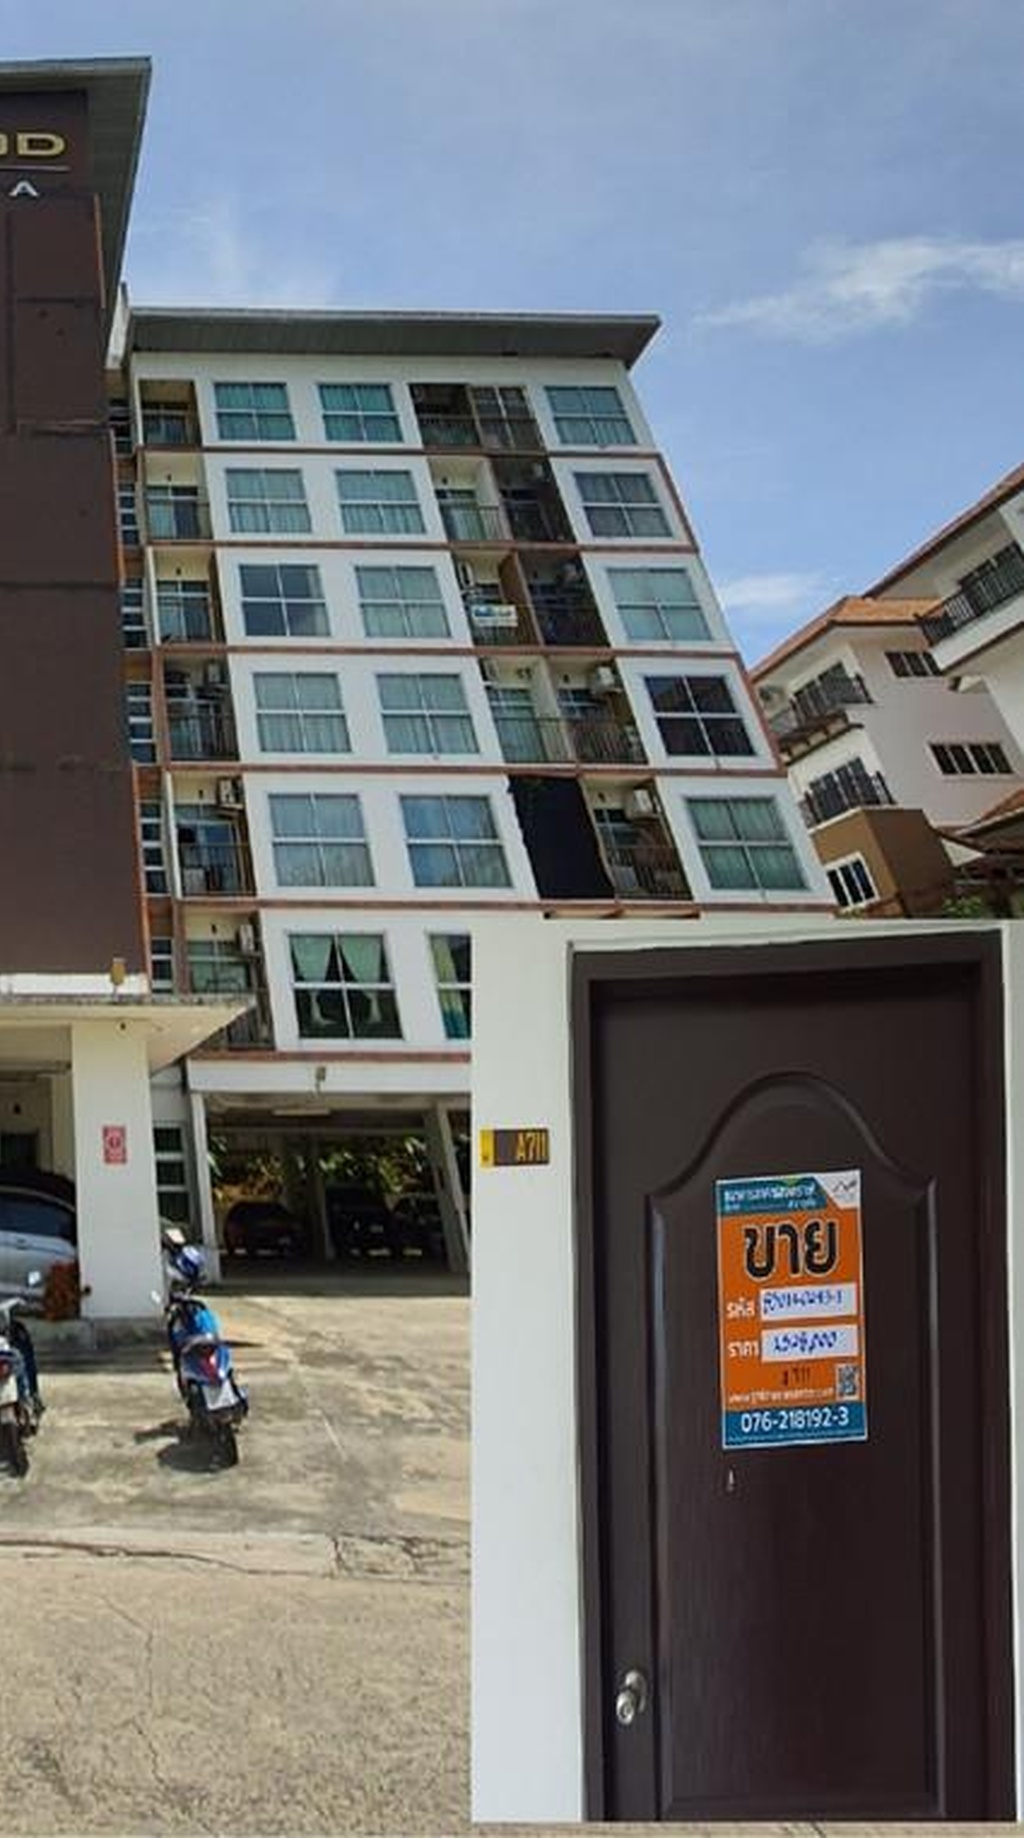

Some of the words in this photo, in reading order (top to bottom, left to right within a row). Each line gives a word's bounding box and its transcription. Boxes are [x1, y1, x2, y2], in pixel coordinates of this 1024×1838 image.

[9, 180, 39, 197] A
[743, 1218, 838, 1281] ขาย
[726, 1296, 756, 1319] รหัส
[727, 1341, 760, 1358] ราคา
[740, 1405, 850, 1434] 076-218192-3
